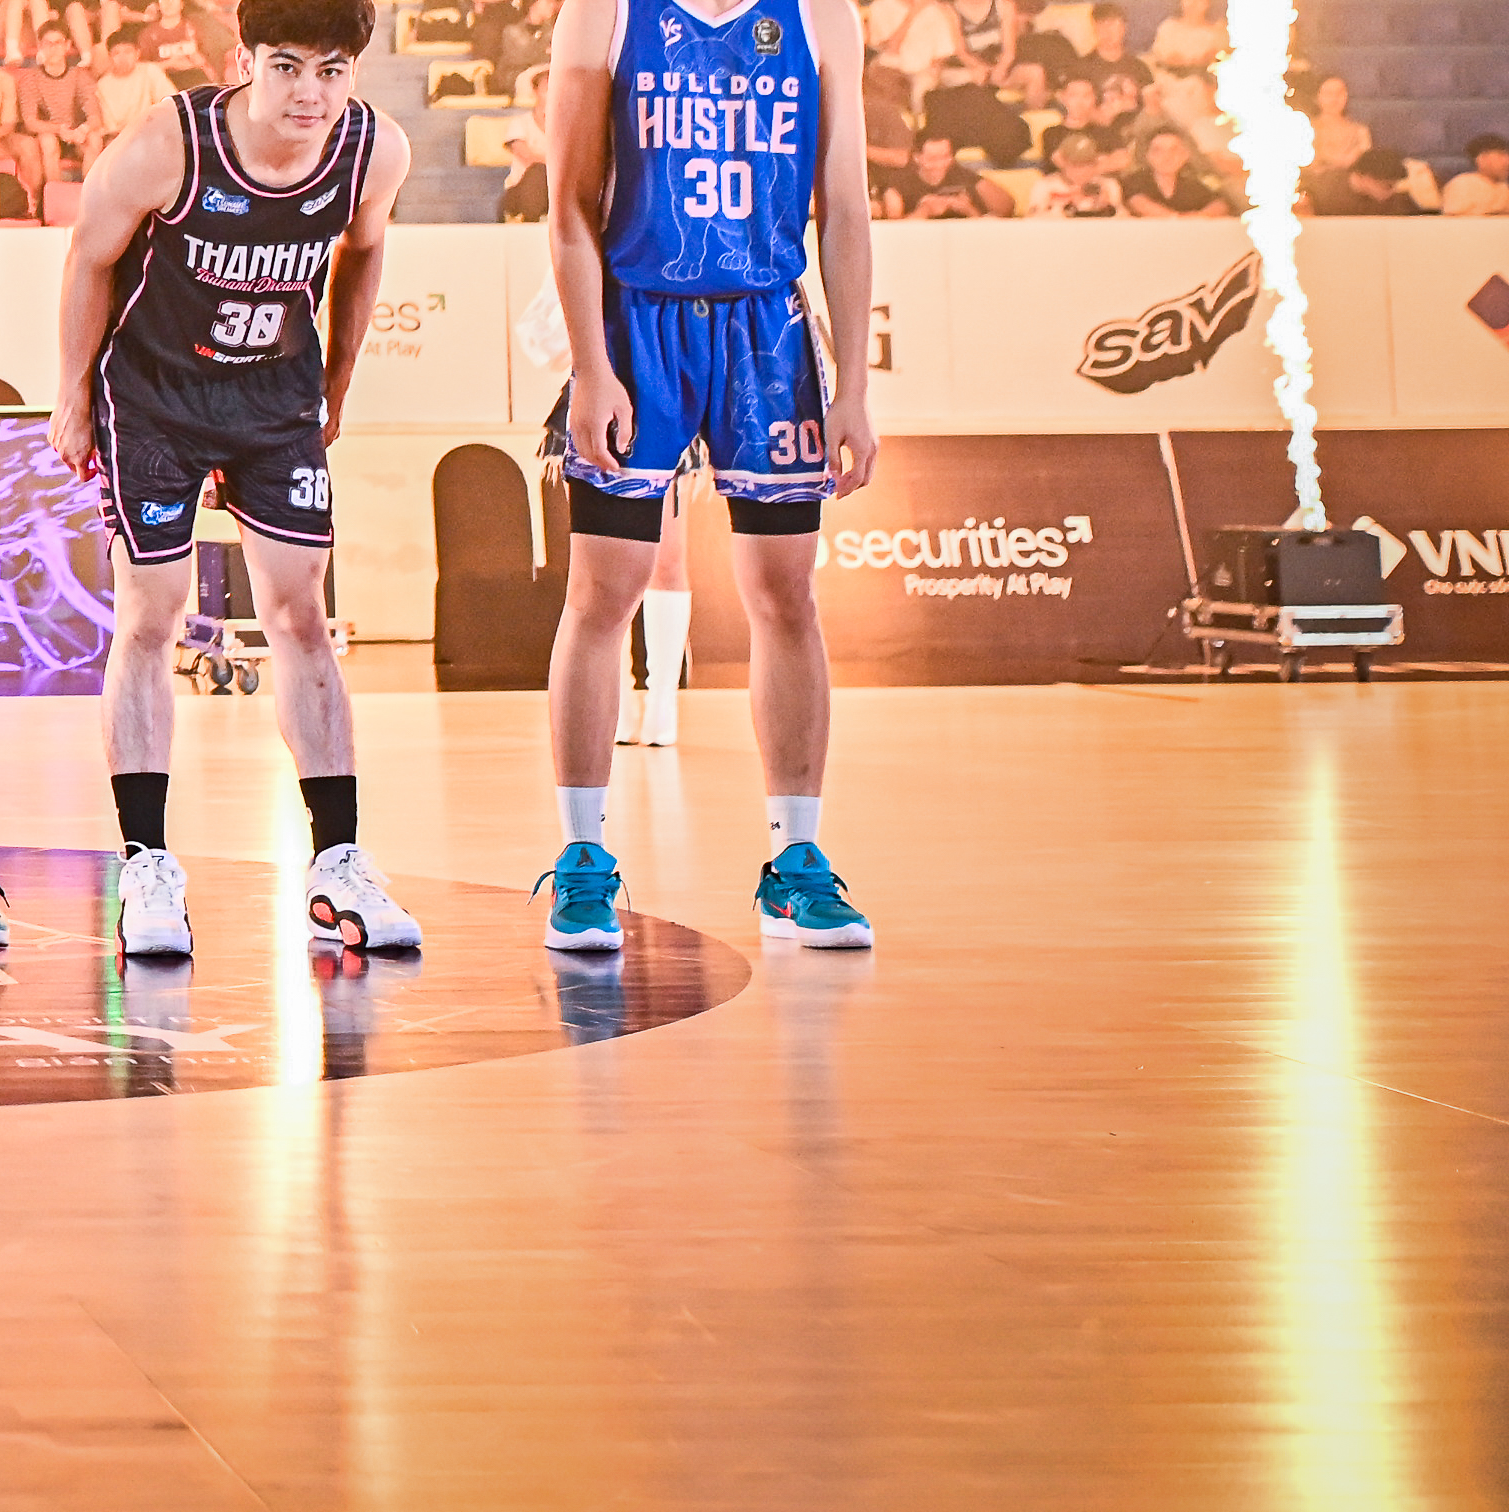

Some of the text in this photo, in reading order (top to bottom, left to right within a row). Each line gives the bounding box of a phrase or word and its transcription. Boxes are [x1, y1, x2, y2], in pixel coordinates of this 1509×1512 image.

[636, 72, 800, 98] BULLDOG
[636, 97, 798, 155] HUSTLE
[683, 157, 753, 221] 30
[194, 268, 255, 292] Tsunami
[768, 419, 824, 466] 30
[834, 516, 1069, 569] securities
[904, 573, 1005, 600] Prosperity
[1029, 572, 1073, 600] Play
